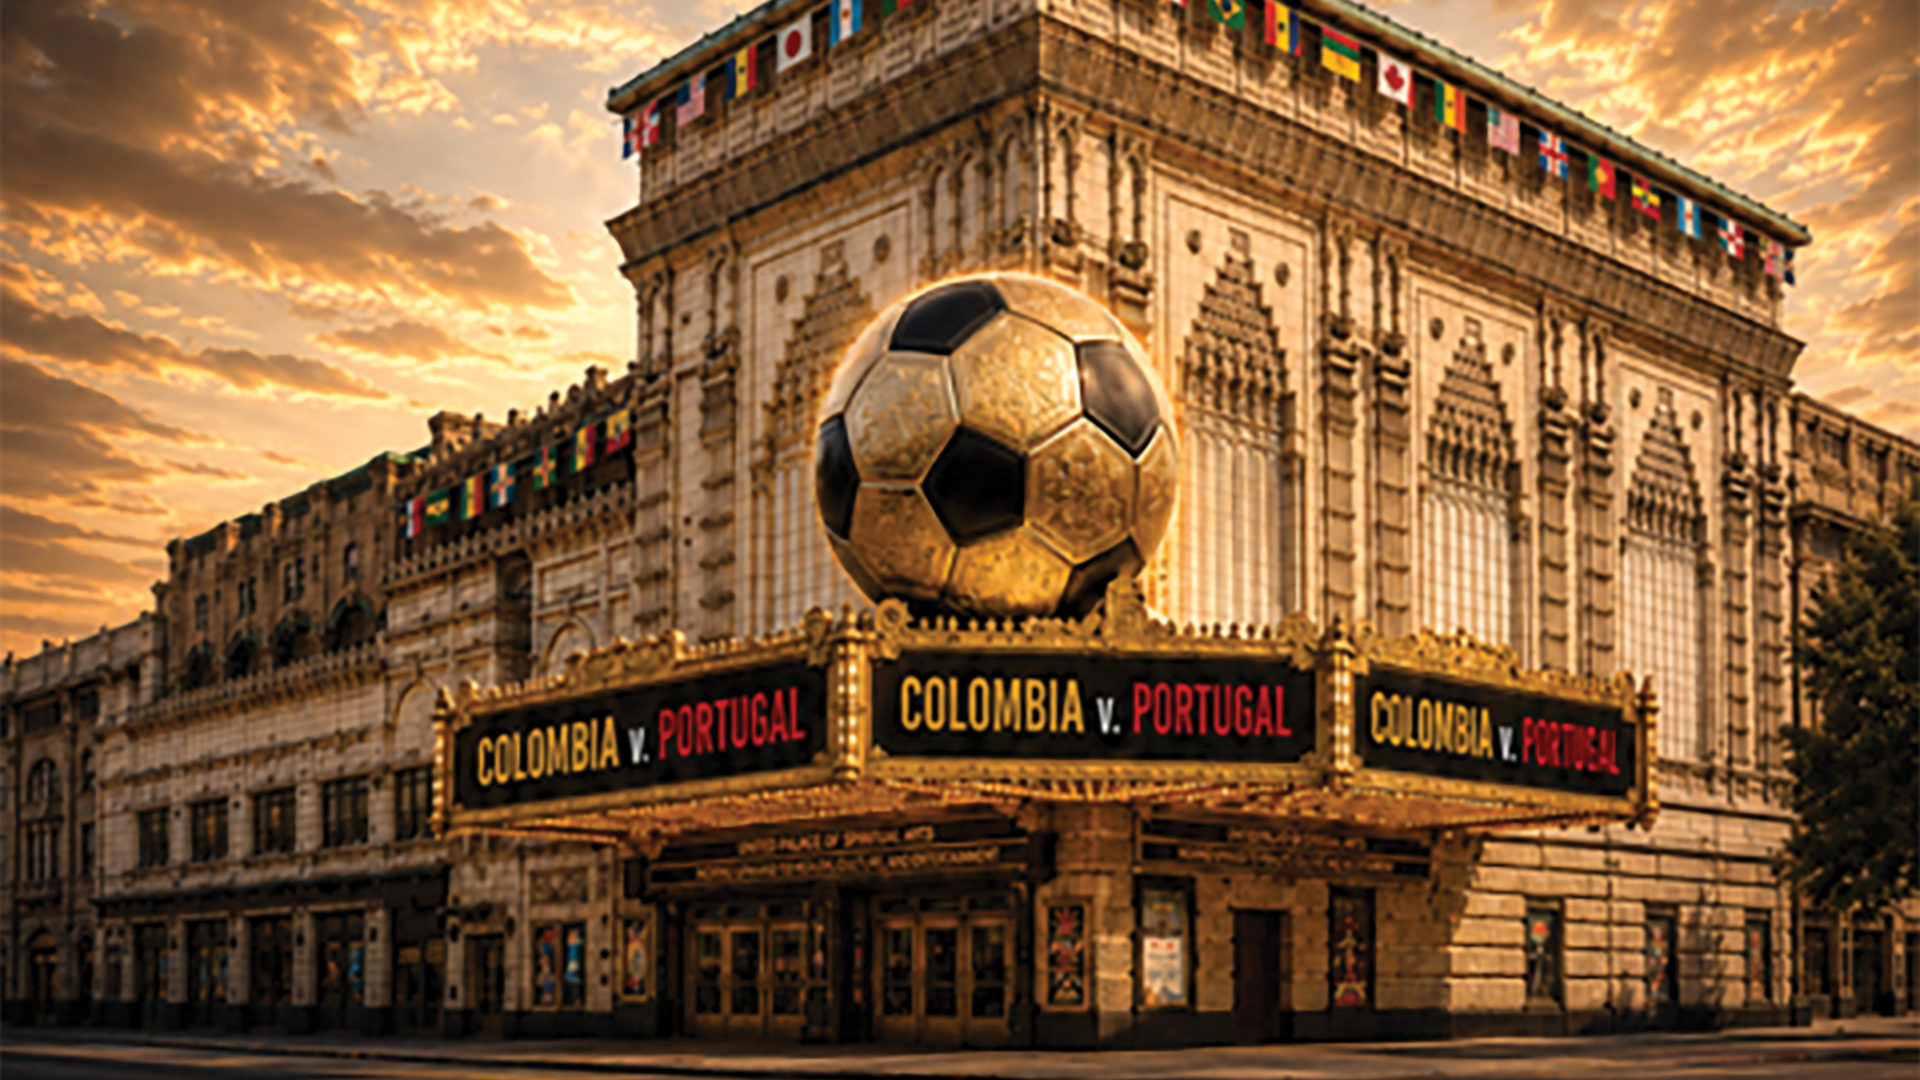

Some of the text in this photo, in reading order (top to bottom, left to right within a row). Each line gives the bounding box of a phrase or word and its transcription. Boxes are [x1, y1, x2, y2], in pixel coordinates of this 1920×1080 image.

[477, 715, 620, 786] COLOMBIA
[658, 687, 806, 760] PORTUGAL
[901, 676, 1085, 733] COLOMBIA
[1133, 682, 1292, 737] PORTUGAL
[1371, 691, 1494, 759] COLOMBIA
